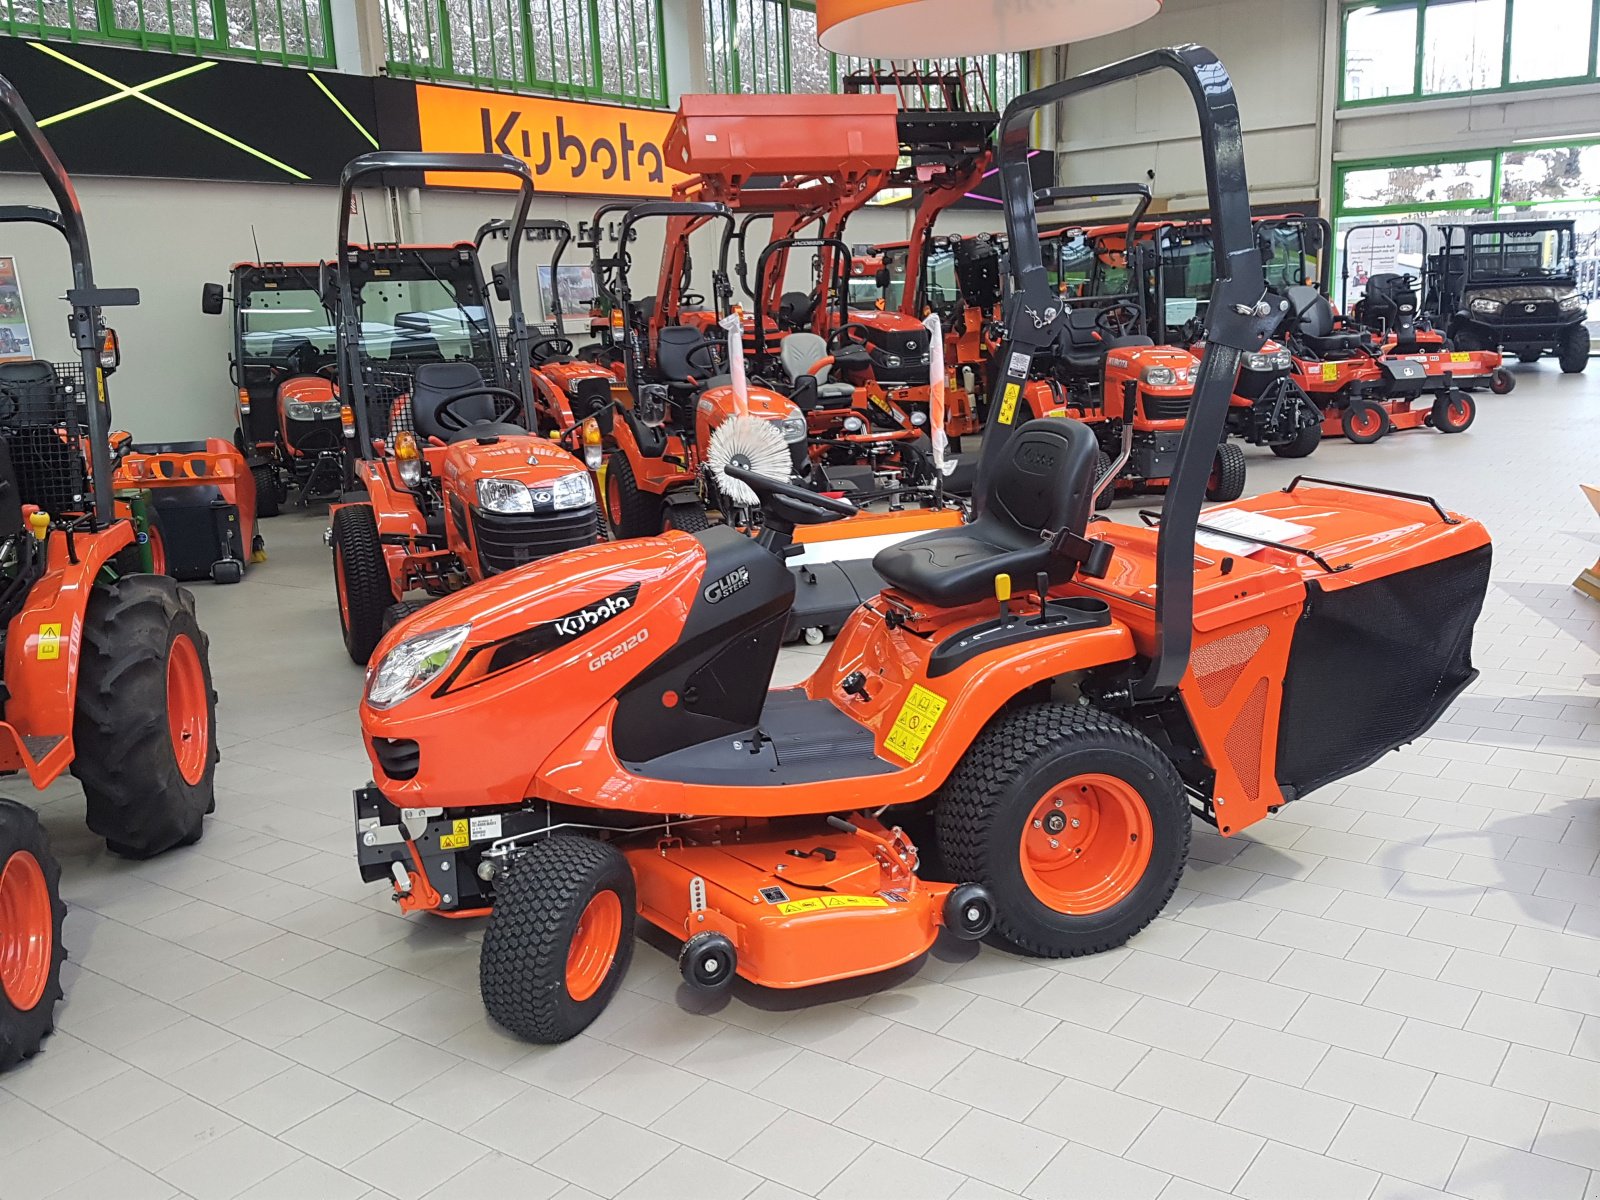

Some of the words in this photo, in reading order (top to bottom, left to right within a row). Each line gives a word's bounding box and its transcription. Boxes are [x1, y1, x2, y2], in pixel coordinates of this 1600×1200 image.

[480, 107, 663, 183] Kubota
[609, 221, 637, 241] Le
[704, 565, 748, 603] GLIDE
[722, 579, 750, 597] STEER
[555, 597, 630, 636] Kubota
[588, 628, 649, 672] GR2120
